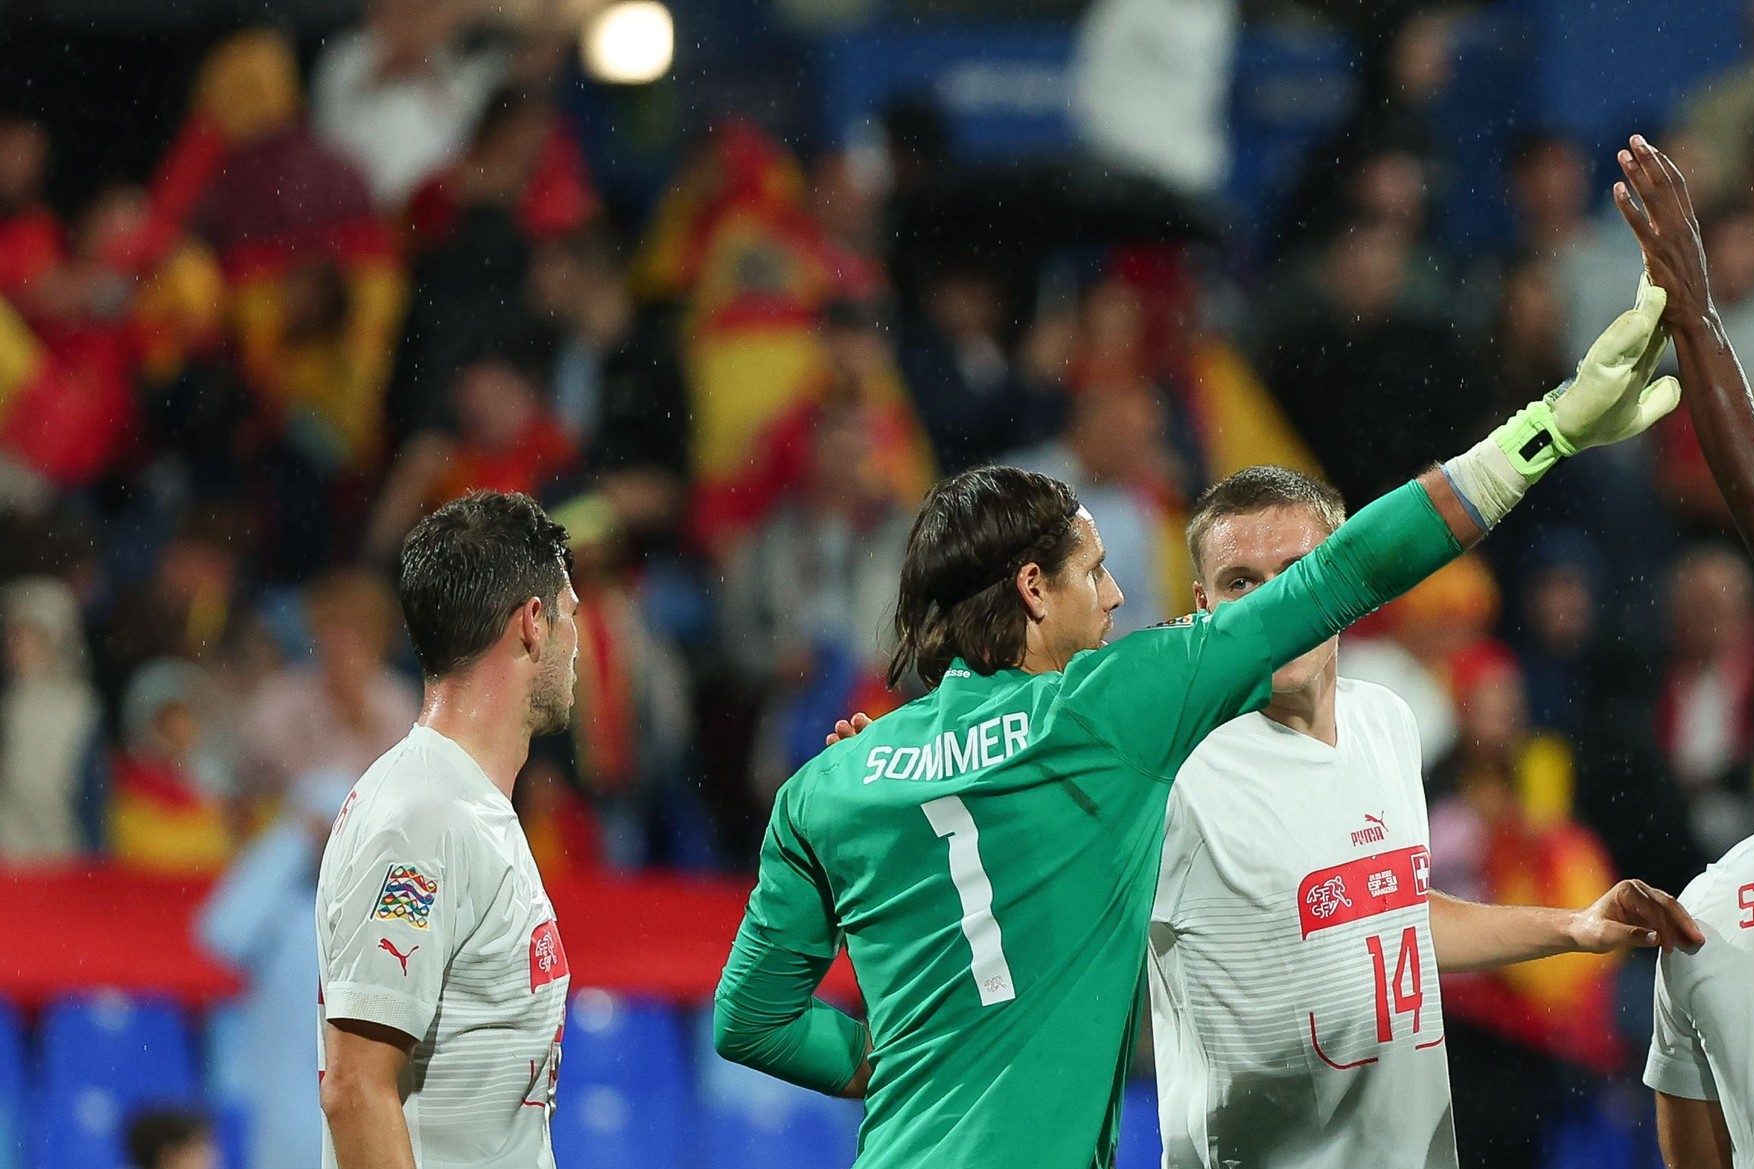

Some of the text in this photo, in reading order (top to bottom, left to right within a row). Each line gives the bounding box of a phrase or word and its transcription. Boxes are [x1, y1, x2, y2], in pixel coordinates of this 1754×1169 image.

[863, 711, 1030, 785] SOMMER
[1351, 826, 1384, 847] PUMA
[920, 795, 1017, 1007] 1
[1365, 926, 1423, 1043] 14
